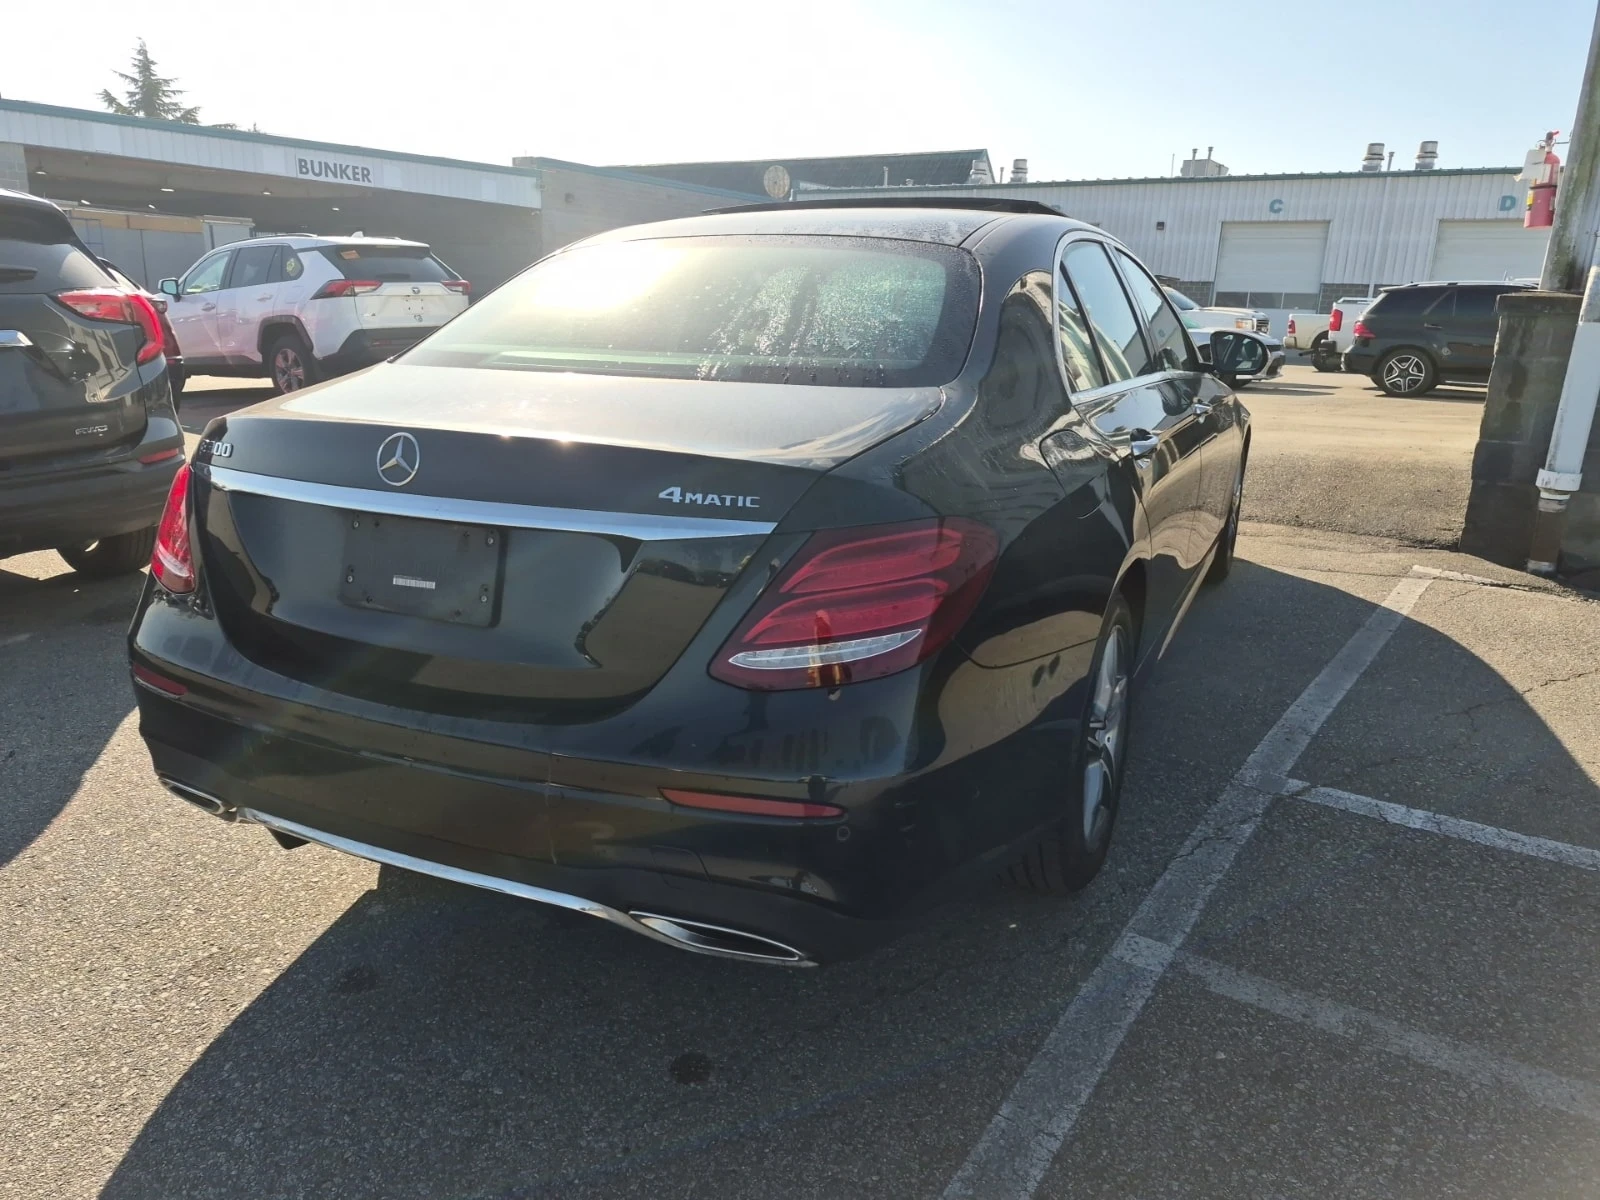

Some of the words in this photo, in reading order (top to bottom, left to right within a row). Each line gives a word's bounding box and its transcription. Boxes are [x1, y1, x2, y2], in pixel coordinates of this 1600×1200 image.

[297, 158, 372, 183] BUNKER
[1269, 199, 1284, 214] C
[1499, 195, 1516, 211] D
[658, 486, 761, 508] 4MATIC
